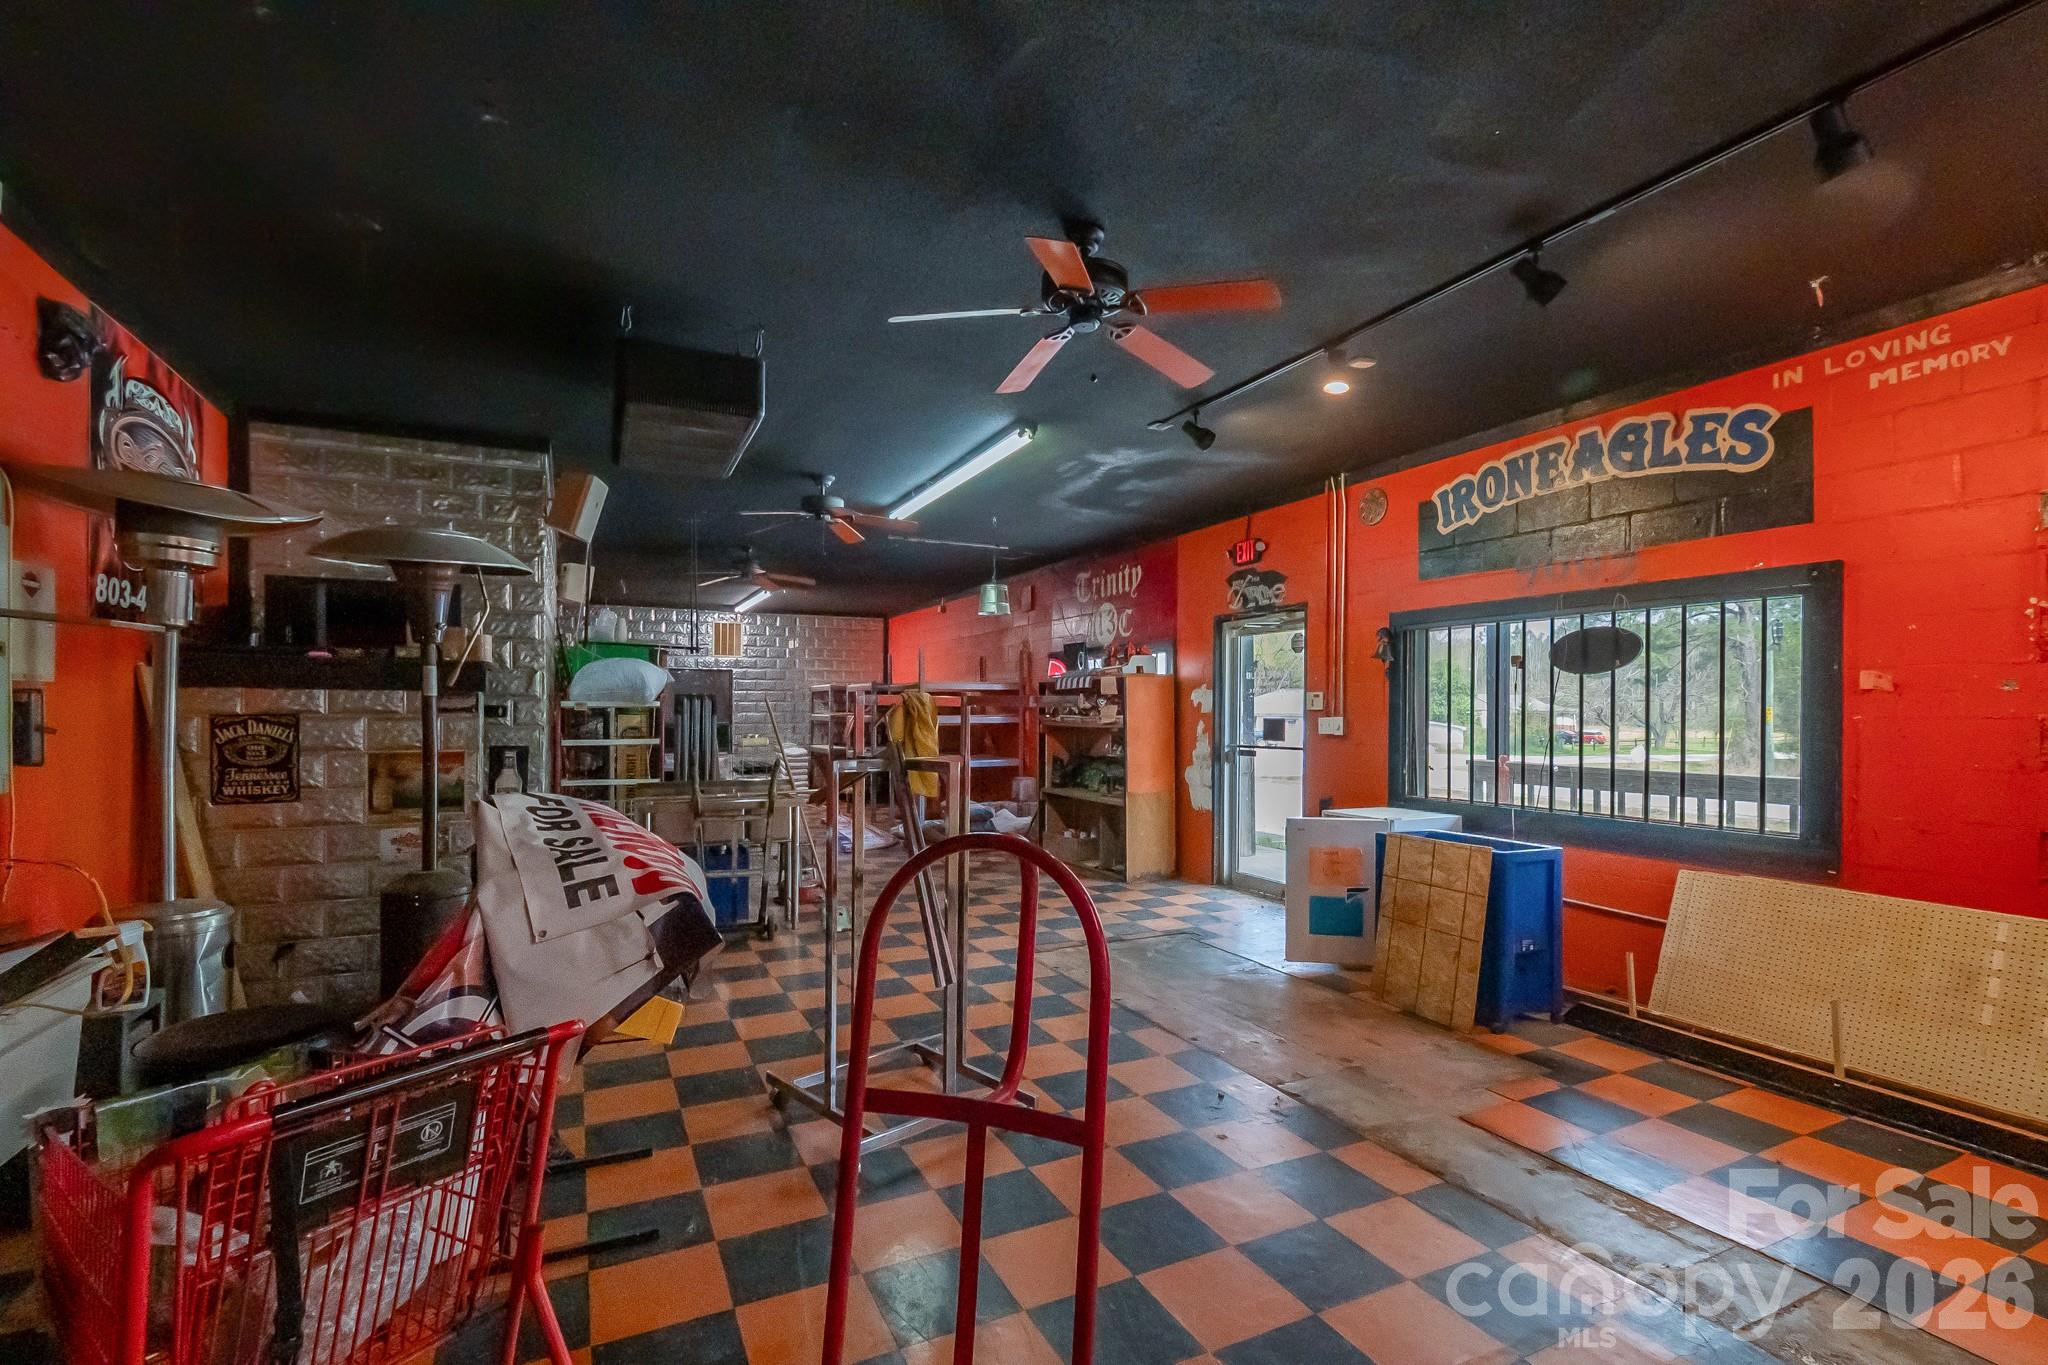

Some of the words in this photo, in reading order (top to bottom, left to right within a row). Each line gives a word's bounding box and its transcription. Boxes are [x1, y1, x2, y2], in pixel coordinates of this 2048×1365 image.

[1772, 366, 1803, 389] IN
[1824, 323, 1951, 376] LOVING
[1869, 336, 2013, 390] MEMORY
[1236, 541, 1254, 564] EXIT
[1075, 564, 1142, 603] Trinity
[214, 723, 247, 745] JACK
[222, 784, 290, 796] WHISKEY
[524, 793, 582, 832] FOR
[543, 836, 620, 910] SALE
